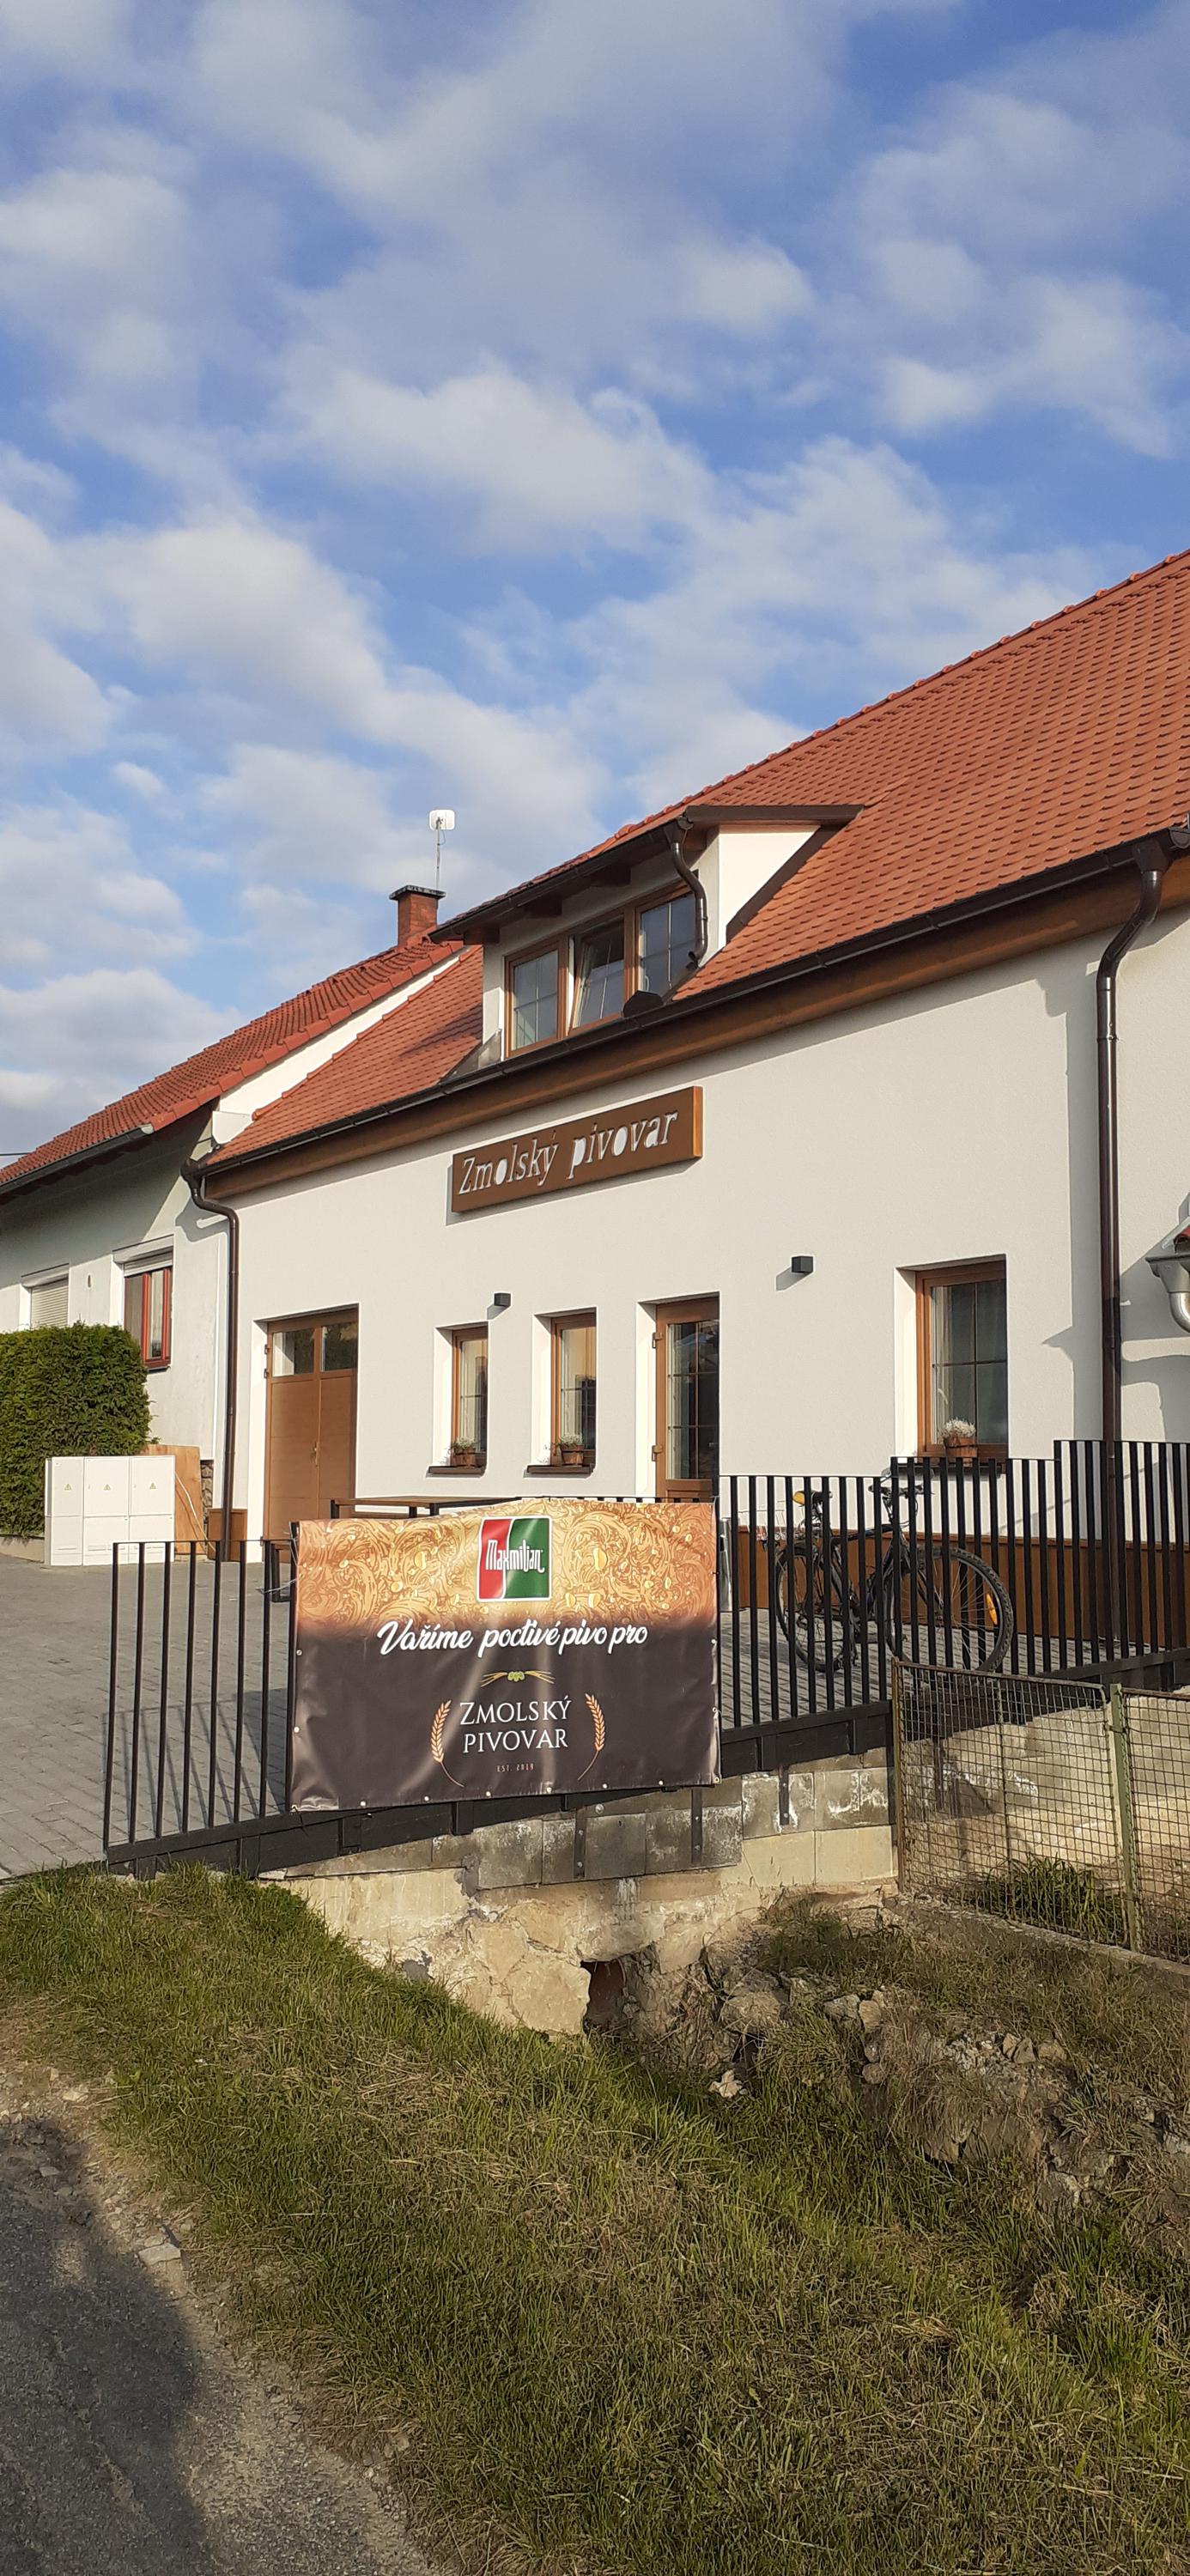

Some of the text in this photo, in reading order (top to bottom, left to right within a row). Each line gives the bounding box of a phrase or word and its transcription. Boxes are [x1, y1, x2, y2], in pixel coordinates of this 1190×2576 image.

[458, 1110, 678, 1195] Zmolský pivovar
[485, 1540, 545, 1573] Maxmilian
[377, 1619, 648, 1658] Vaříme poctivé pivo pro
[459, 1695, 572, 1725] ZMOLSKÝ
[463, 1728, 568, 1753] PIVOVAR
